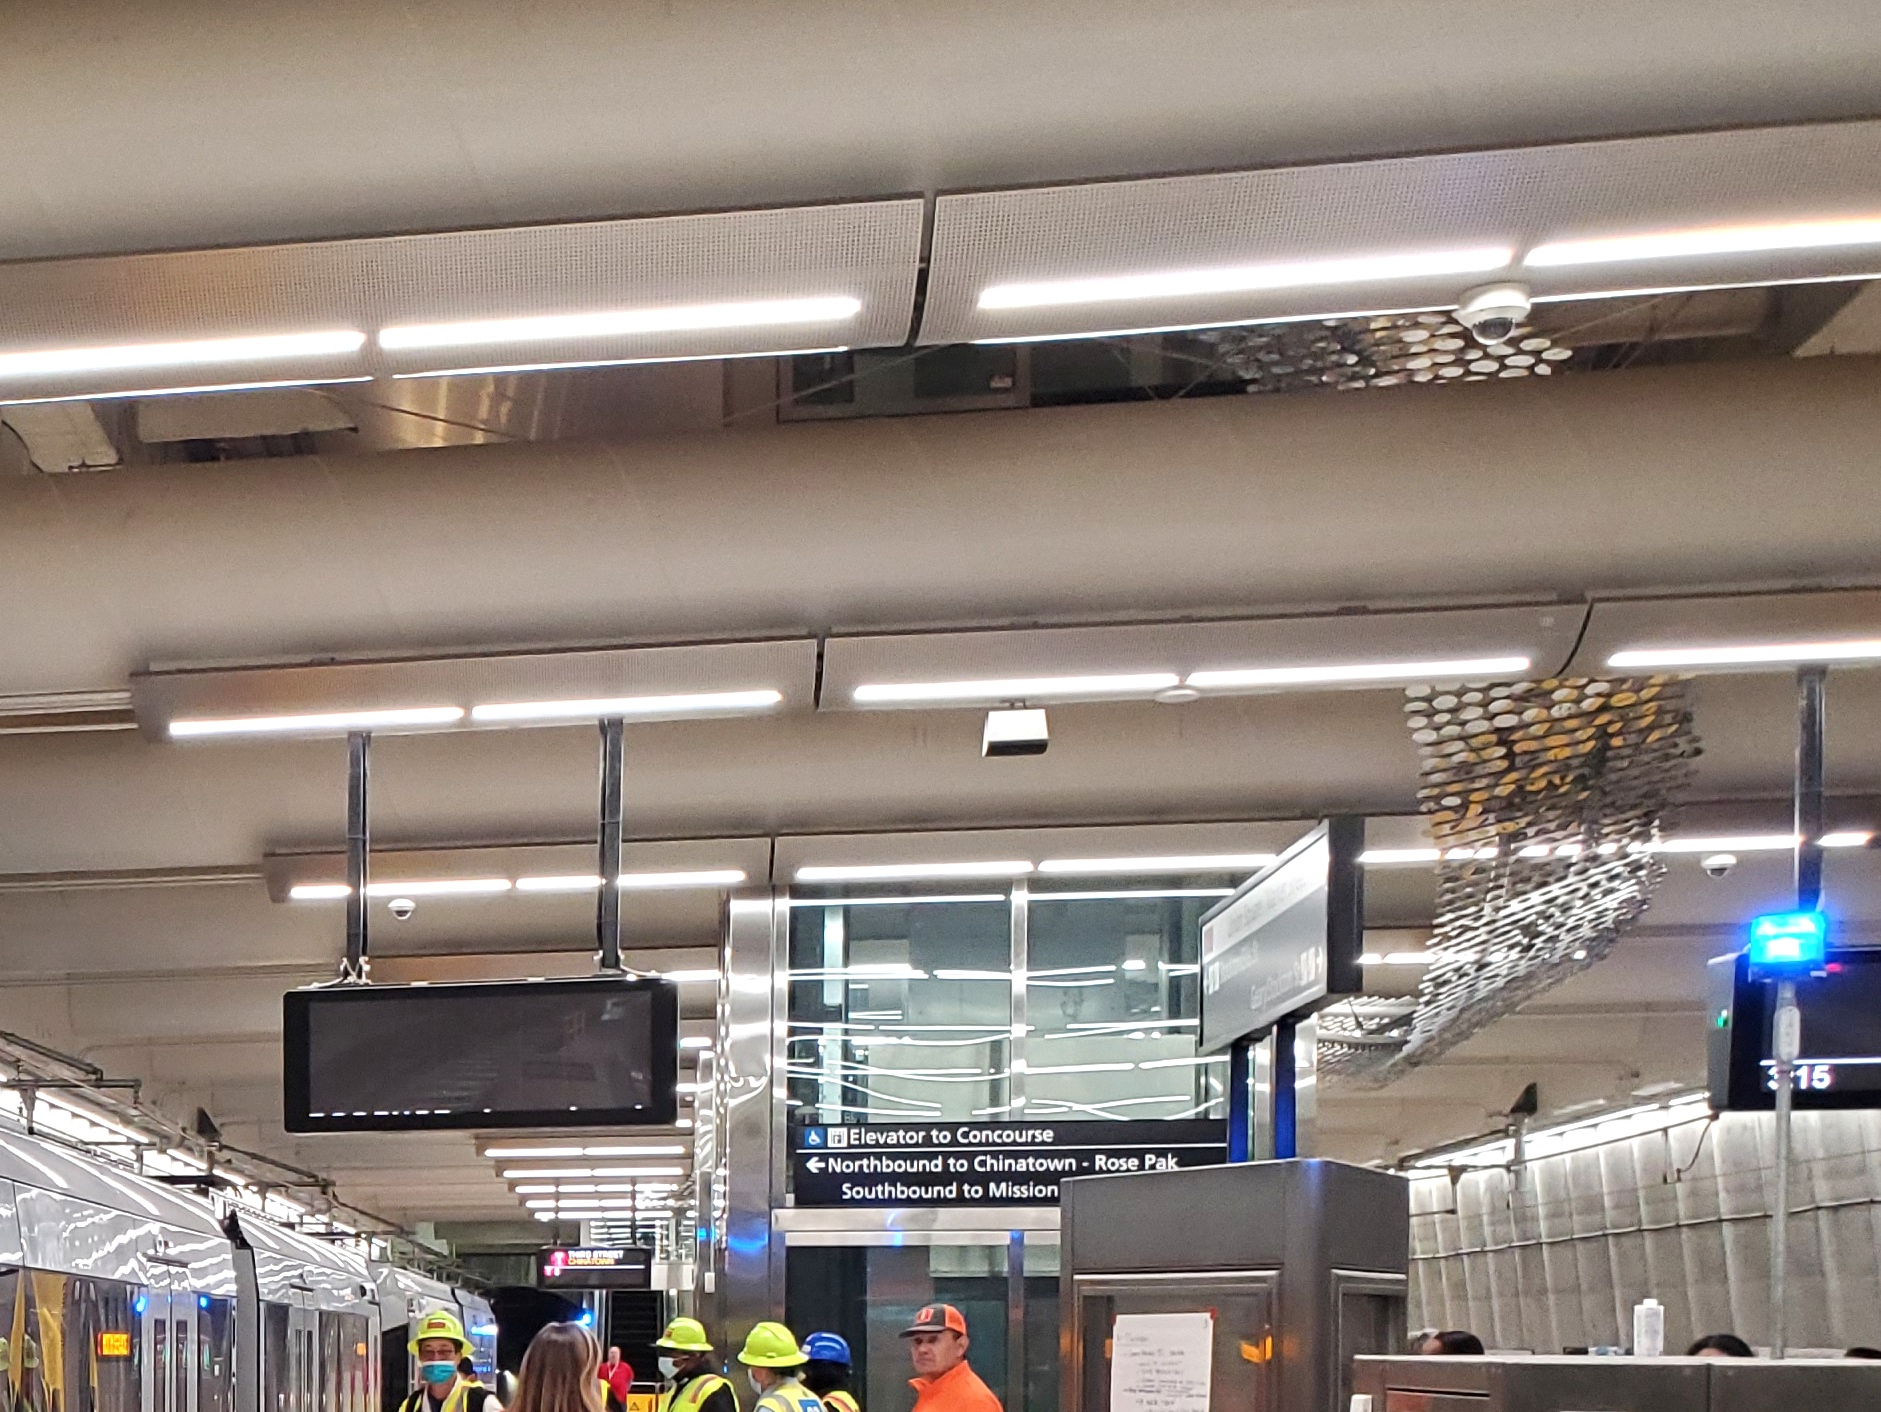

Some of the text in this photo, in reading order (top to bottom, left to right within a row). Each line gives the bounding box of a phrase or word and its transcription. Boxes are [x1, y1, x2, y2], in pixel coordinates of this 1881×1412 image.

[849, 1127, 1055, 1145] Elevator to Concourse
[828, 1156, 942, 1173] Northbound
[947, 1158, 968, 1173] to
[974, 1154, 1076, 1173] Chinatown
[1095, 1155, 1139, 1171] Rose
[1145, 1153, 1179, 1170] Pak
[841, 1181, 1059, 1200] Southbound to Mission
